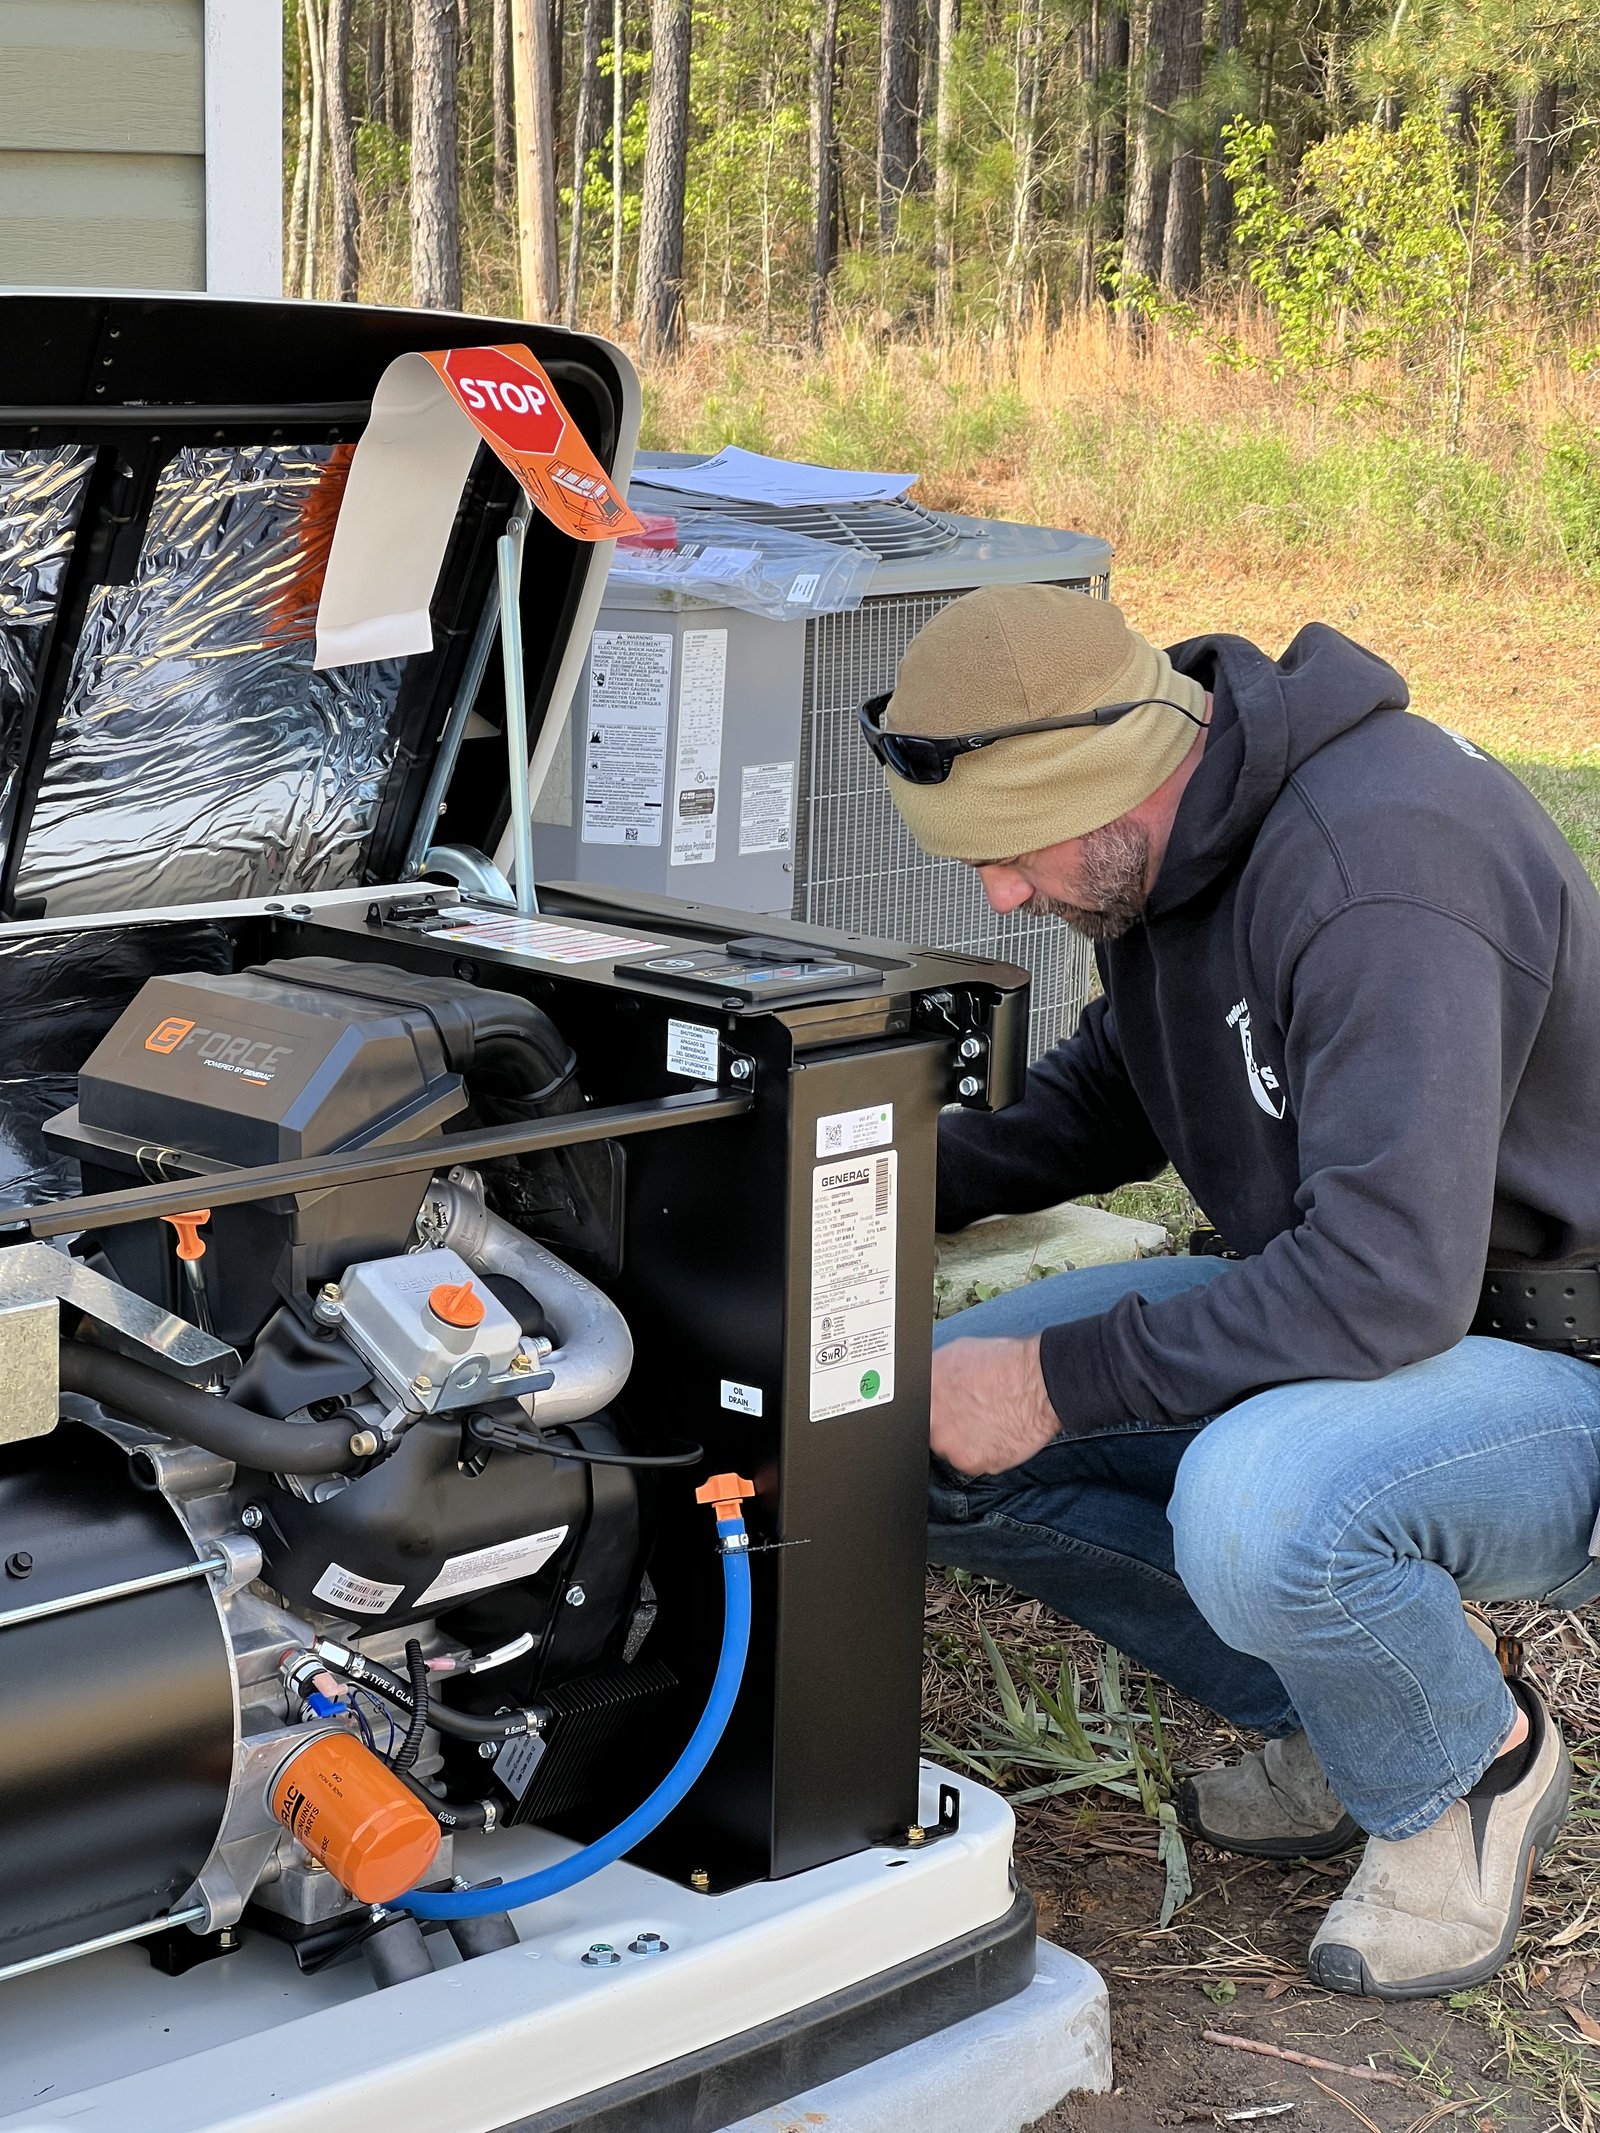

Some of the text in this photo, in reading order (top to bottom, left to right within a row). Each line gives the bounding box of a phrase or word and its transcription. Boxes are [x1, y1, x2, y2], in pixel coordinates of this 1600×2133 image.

[458, 378, 547, 416] STOP
[670, 1021, 717, 1036] GENERATOR EMERGENCY
[680, 1030, 703, 1039] SHUTDOWN
[681, 1039, 699, 1047] APAGADO
[681, 1045, 706, 1055] EMERGENCIA
[684, 1052, 709, 1061] GENERADOR
[203, 1059, 272, 1081] POWERED BY GENERAC
[822, 1169, 870, 1186] GENERAC
[733, 1387, 743, 1396] OIL
[729, 1395, 748, 1406] DRAIN
[370, 1674, 390, 1690] TYPE
[388, 1685, 396, 1693] A
[303, 1807, 320, 1837] PARTS
